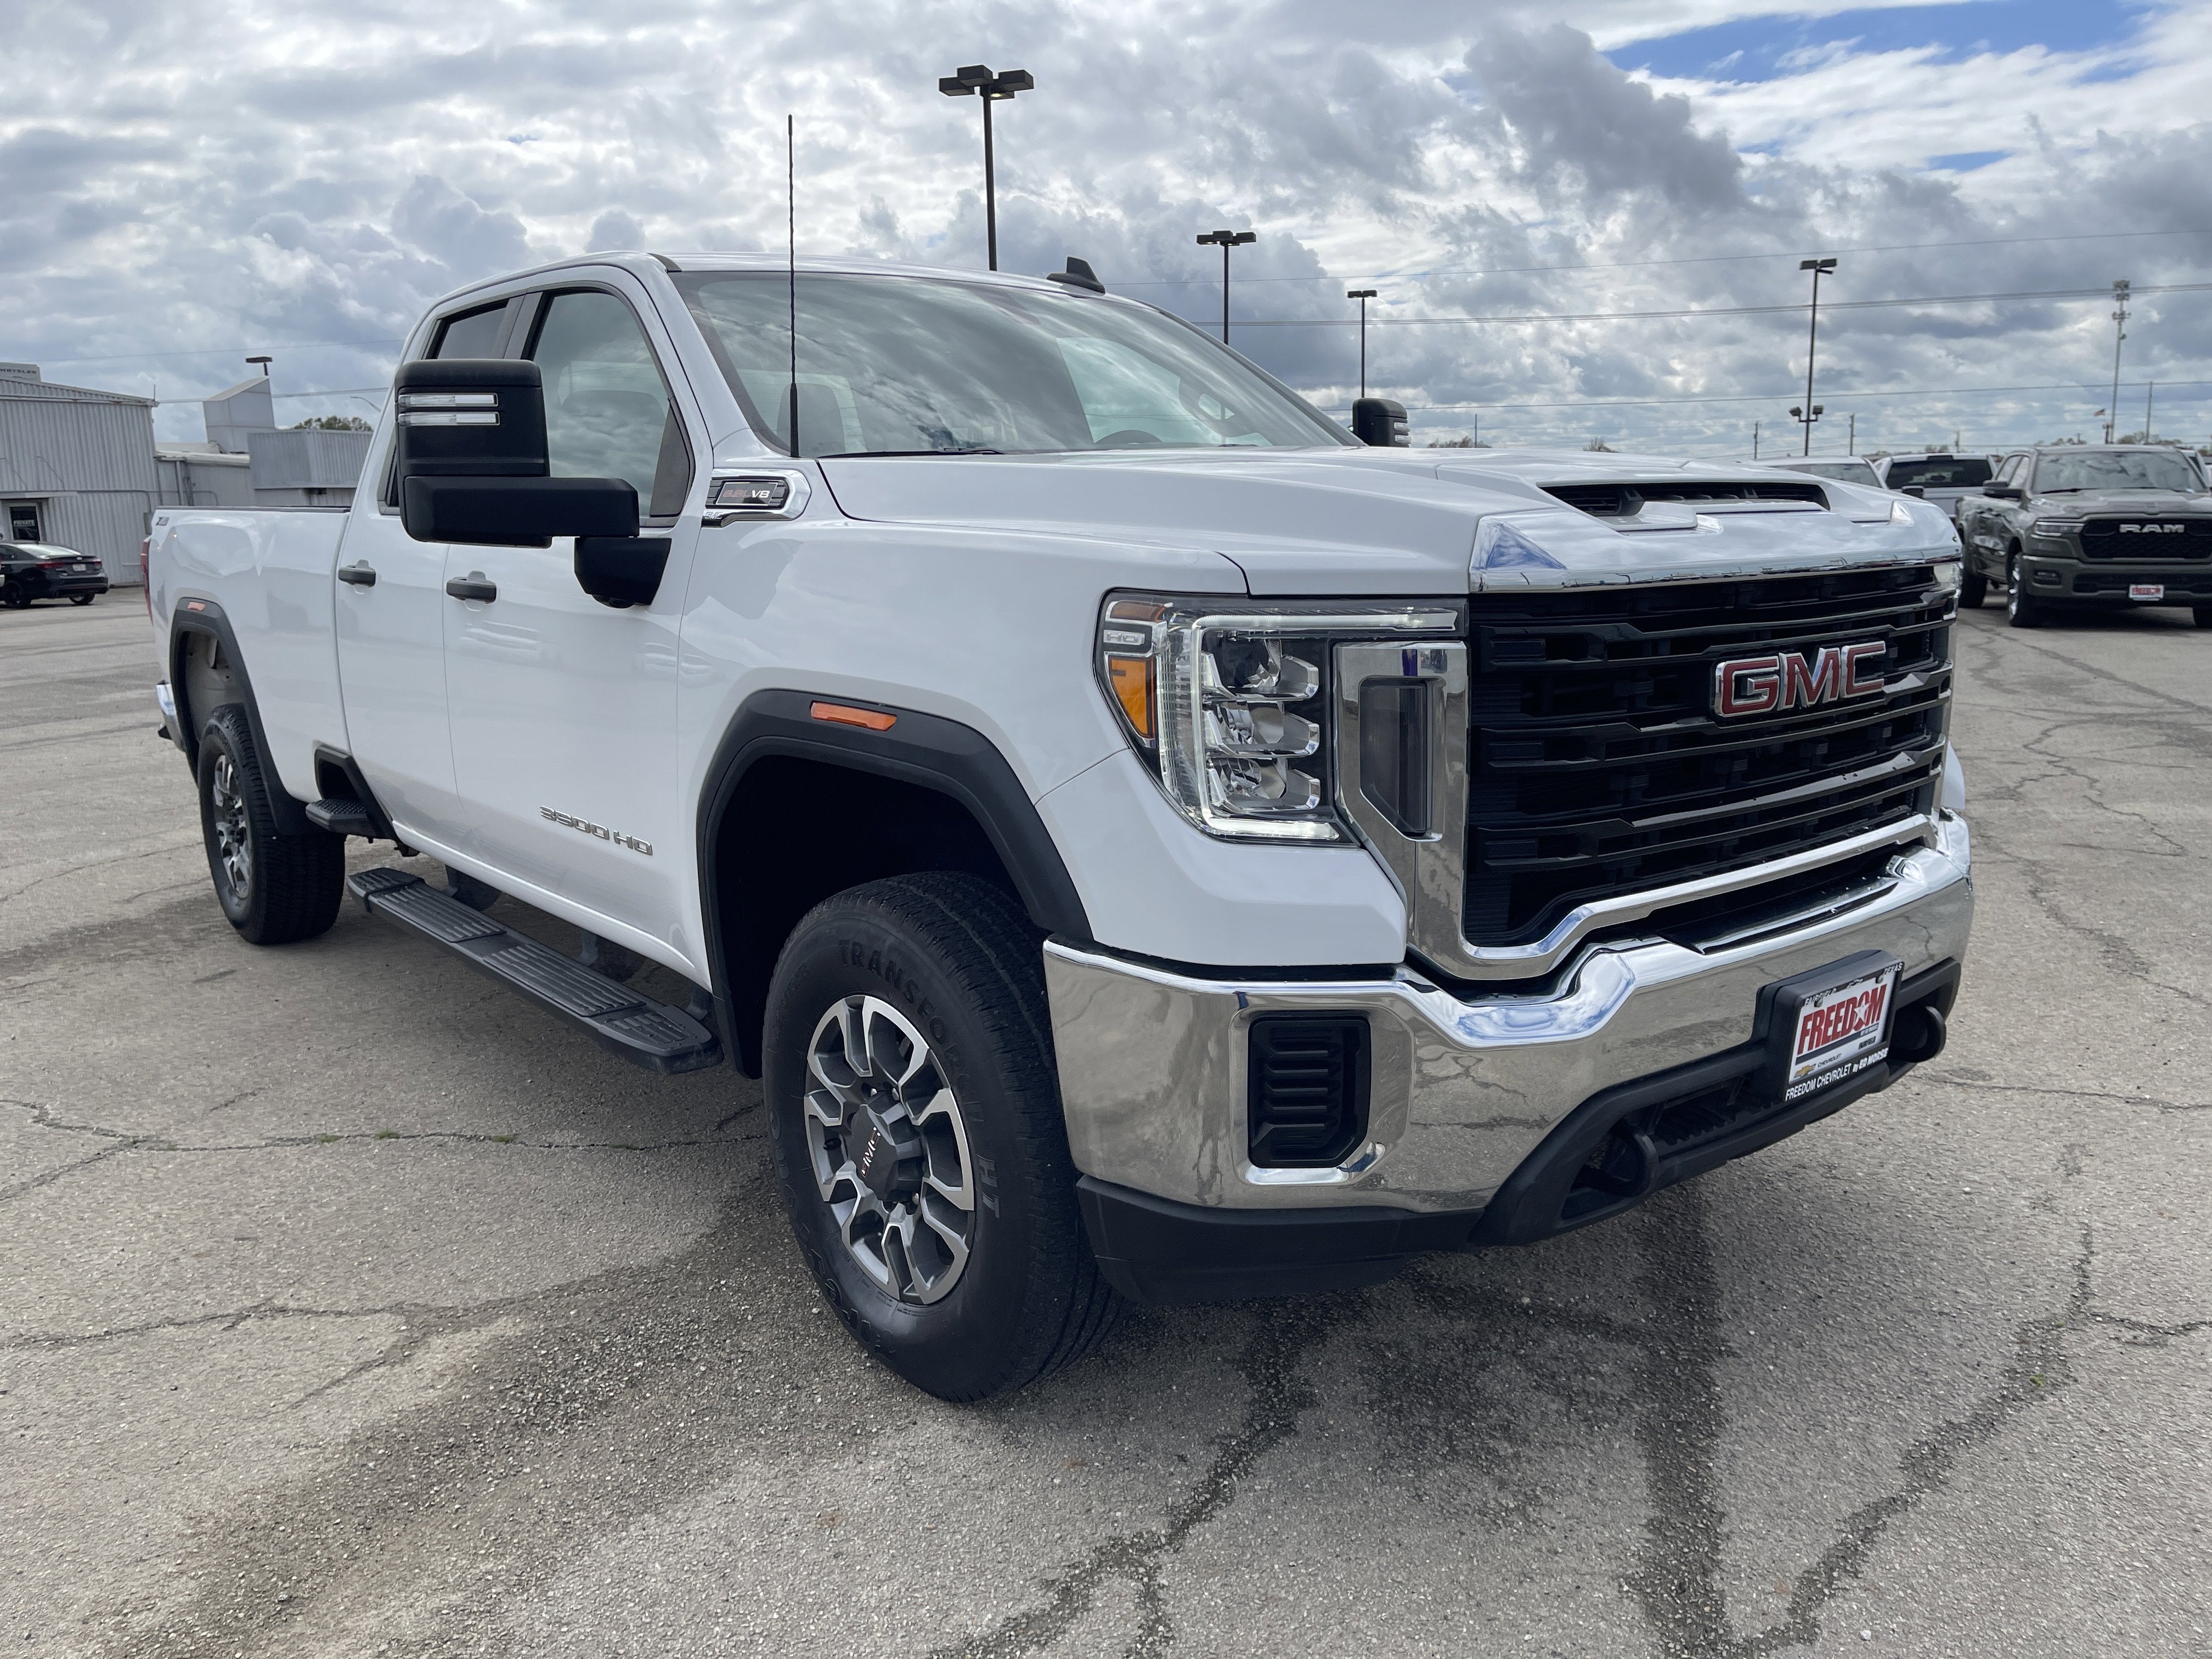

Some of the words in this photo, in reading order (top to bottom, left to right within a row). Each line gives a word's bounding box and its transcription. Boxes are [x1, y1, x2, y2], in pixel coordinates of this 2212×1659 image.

[752, 490, 770, 498] V8
[704, 511, 723, 520] GMC
[2119, 524, 2185, 533] RAM
[1714, 641, 1886, 718] GMC
[540, 805, 610, 840] 3500
[613, 830, 653, 856] HD
[1883, 963, 1903, 974] TEXAS
[1797, 984, 1887, 1056] FREEDOM
[1818, 1053, 1842, 1068] CHEVROLET
[839, 938, 985, 1123] TRANSFORCE
[977, 1155, 1000, 1220] HT
[1785, 1078, 1816, 1102] FREEDOM
[1816, 1063, 1852, 1088] CHEVROLET
[1858, 1058, 1868, 1069] ED
